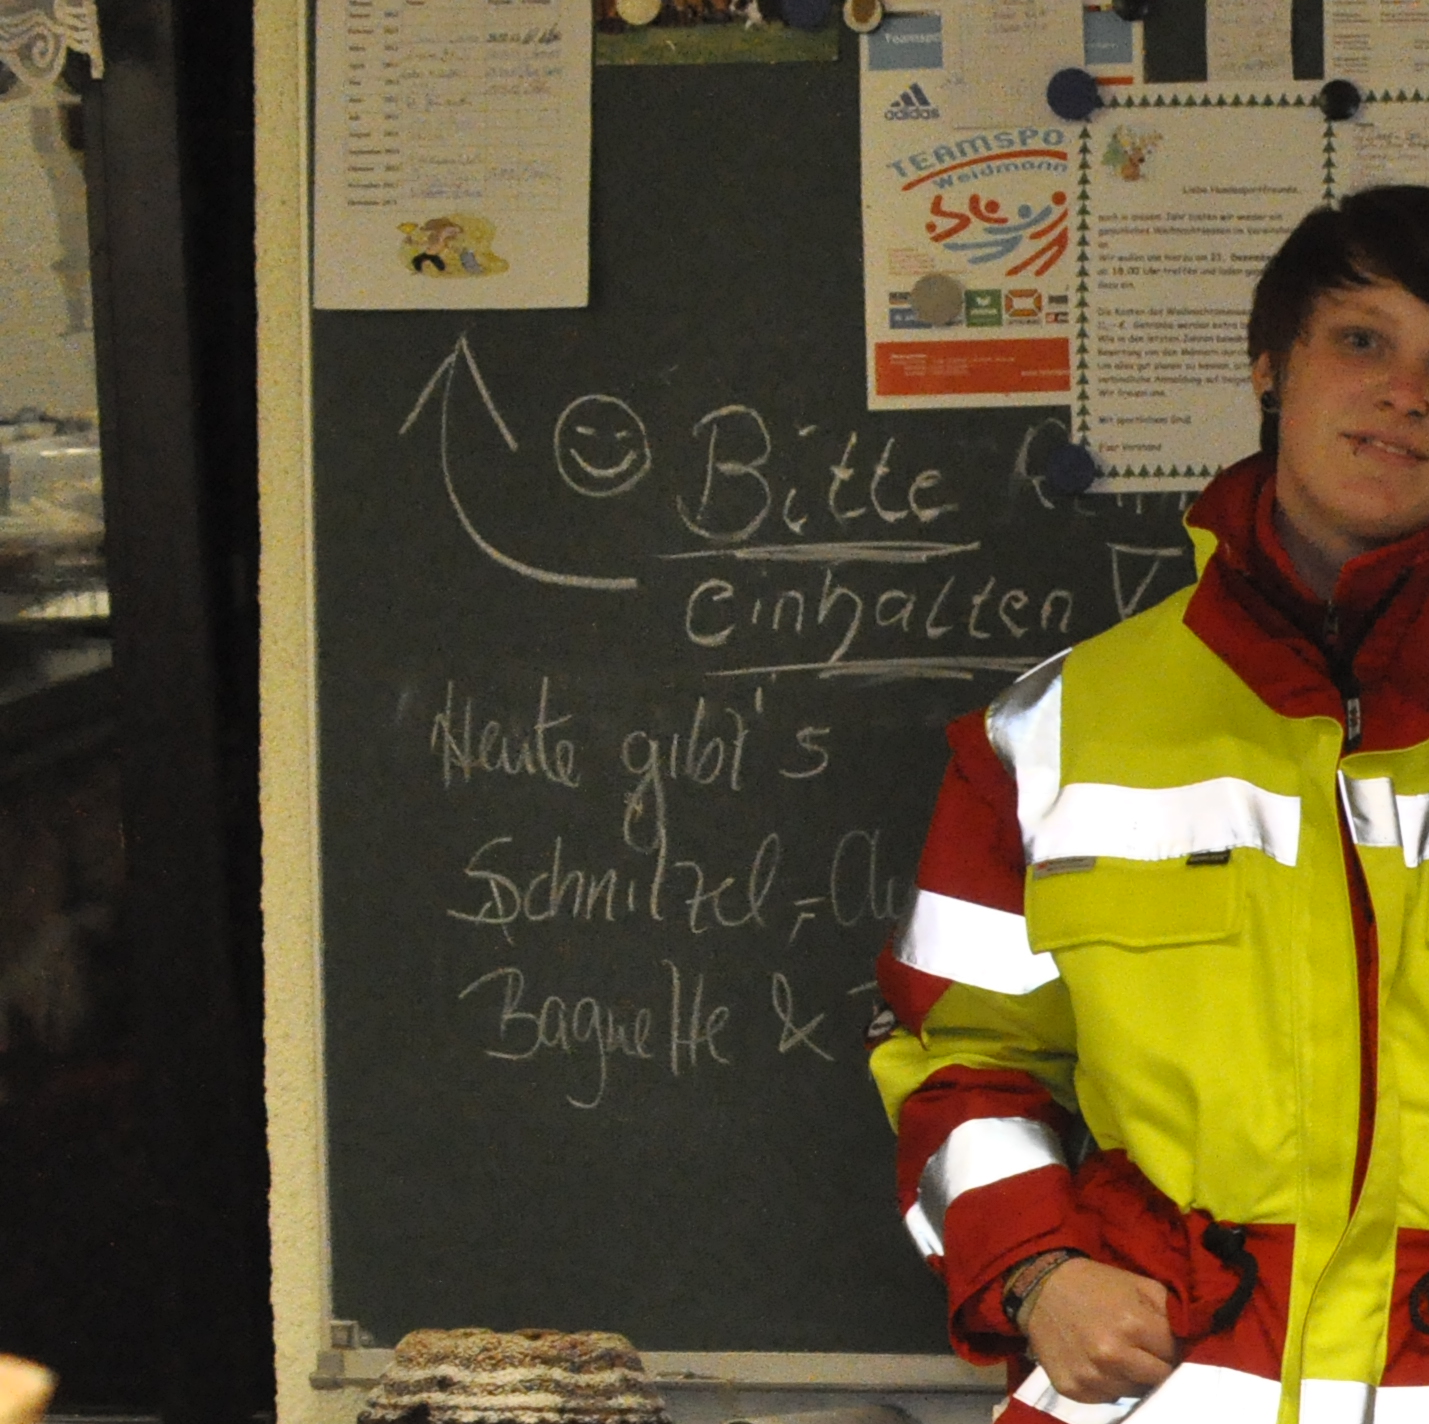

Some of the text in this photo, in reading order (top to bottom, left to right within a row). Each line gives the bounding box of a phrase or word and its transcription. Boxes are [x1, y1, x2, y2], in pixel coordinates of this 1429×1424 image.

[884, 107, 940, 121] adidas
[677, 405, 959, 542] Bitte
[686, 567, 1073, 664] einhalten
[431, 677, 580, 789] Heute
[458, 959, 834, 1109] Baguette &
